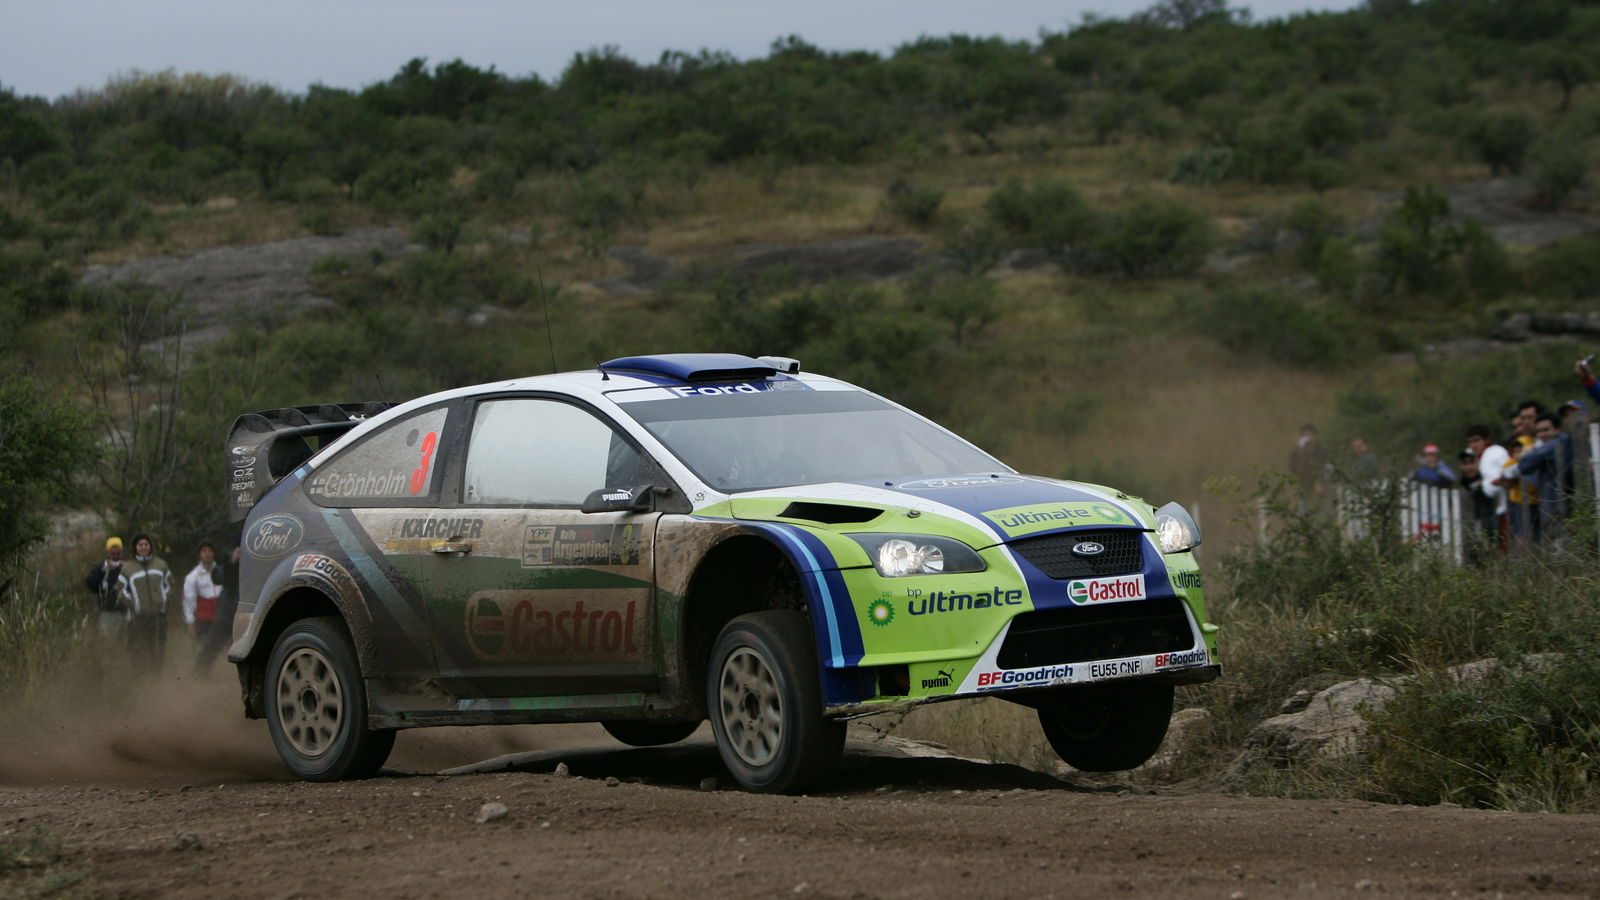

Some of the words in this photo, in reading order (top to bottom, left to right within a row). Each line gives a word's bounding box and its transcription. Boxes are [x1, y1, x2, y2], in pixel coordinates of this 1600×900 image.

[674, 383, 761, 397] Ford
[409, 431, 437, 495] 3
[324, 469, 406, 497] Grönholm
[602, 493, 629, 501] PUMA
[1001, 508, 1091, 527] ultimate
[254, 521, 292, 551] Ford
[531, 528, 552, 537] YPF
[621, 524, 633, 565] 3
[1081, 544, 1099, 552] Ford
[907, 587, 922, 597] bp
[1089, 578, 1142, 601] Castrol
[908, 586, 1023, 616] ultimate
[511, 600, 638, 655] Castrol
[1155, 649, 1206, 668] BFGoodrich
[977, 665, 1073, 686] BFGoodrich
[1091, 664, 1118, 678] EU55
[921, 677, 949, 689] PUMA
